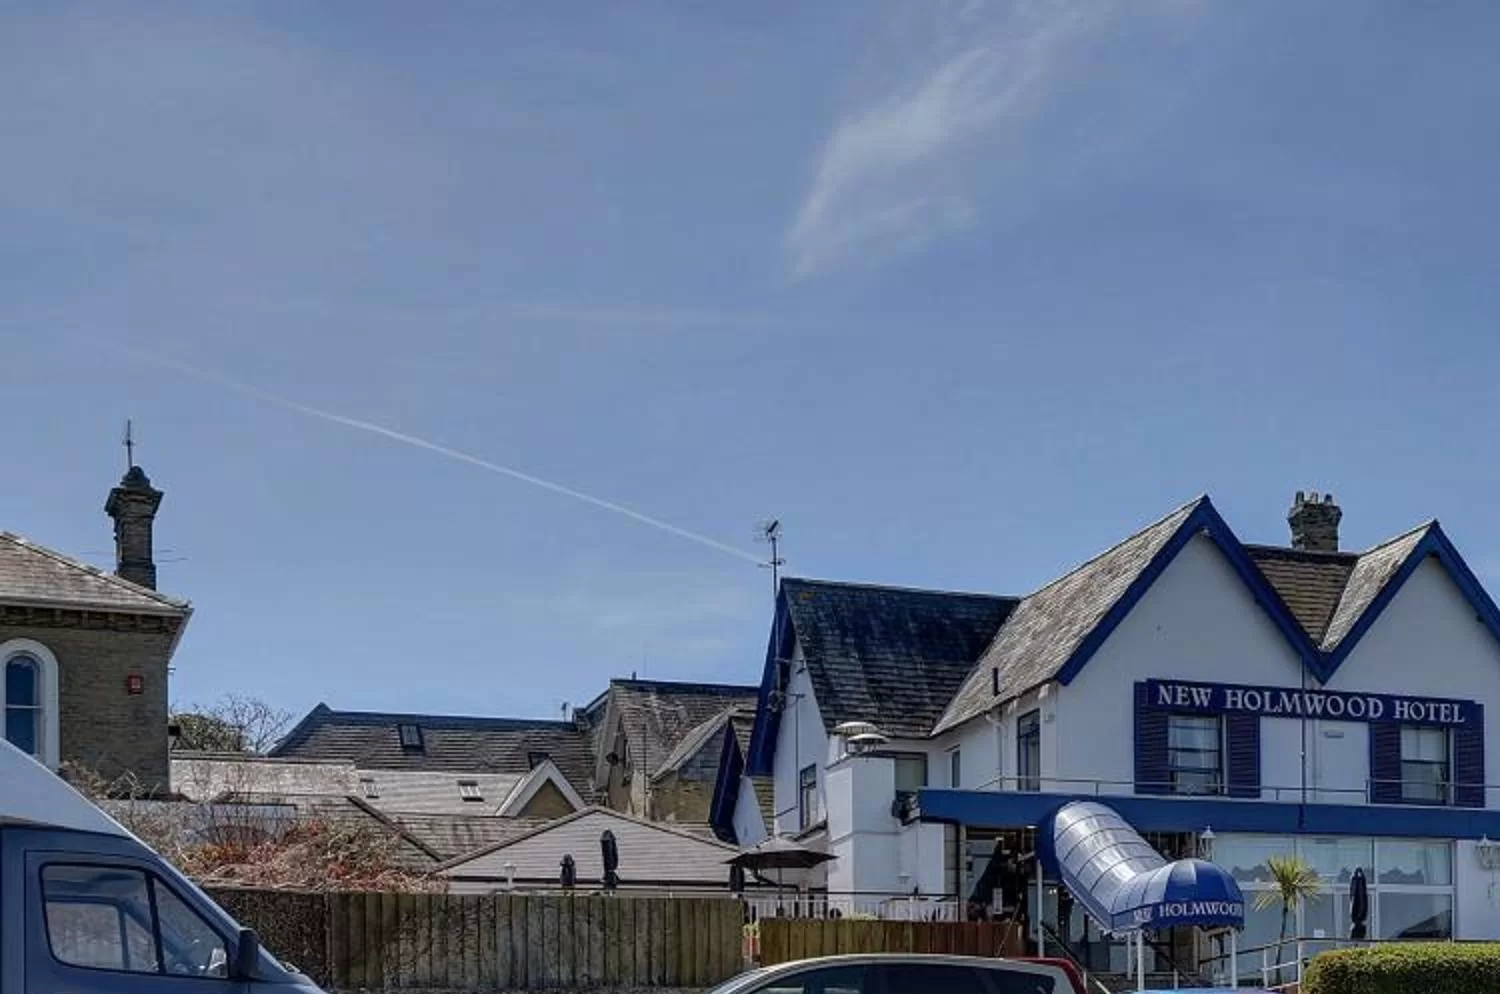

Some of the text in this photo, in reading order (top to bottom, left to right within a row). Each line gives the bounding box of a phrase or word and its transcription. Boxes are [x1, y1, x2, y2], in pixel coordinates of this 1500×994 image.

[1158, 685, 1466, 723] NEW HOLMWOOD HOTEL
